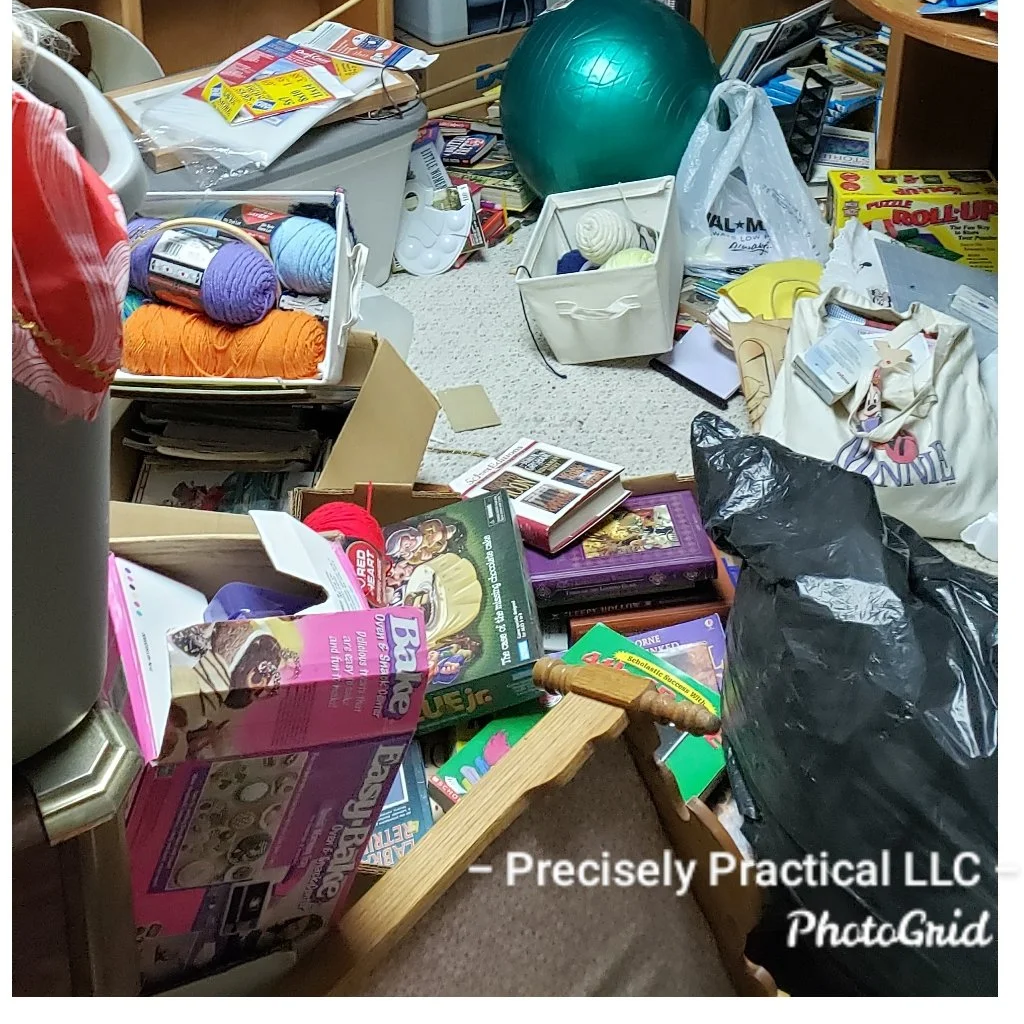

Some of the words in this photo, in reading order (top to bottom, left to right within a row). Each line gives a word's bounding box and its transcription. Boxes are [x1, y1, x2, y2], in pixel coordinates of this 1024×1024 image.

[420, 148, 435, 173] LITTLE
[866, 198, 913, 211] PUZZLE
[355, 549, 367, 577] RED
[486, 551, 498, 583] chocolate
[490, 581, 504, 610] missing
[375, 613, 387, 639] Oven
[495, 608, 505, 622] the
[329, 635, 338, 652] and
[342, 635, 353, 652] are
[355, 631, 367, 666] Delicious
[499, 633, 509, 650] case
[342, 653, 355, 675] easy
[388, 614, 421, 719] Bake
[501, 649, 511, 666] The
[628, 655, 664, 678] Scholastic
[662, 673, 690, 696] Success
[690, 690, 707, 707] With
